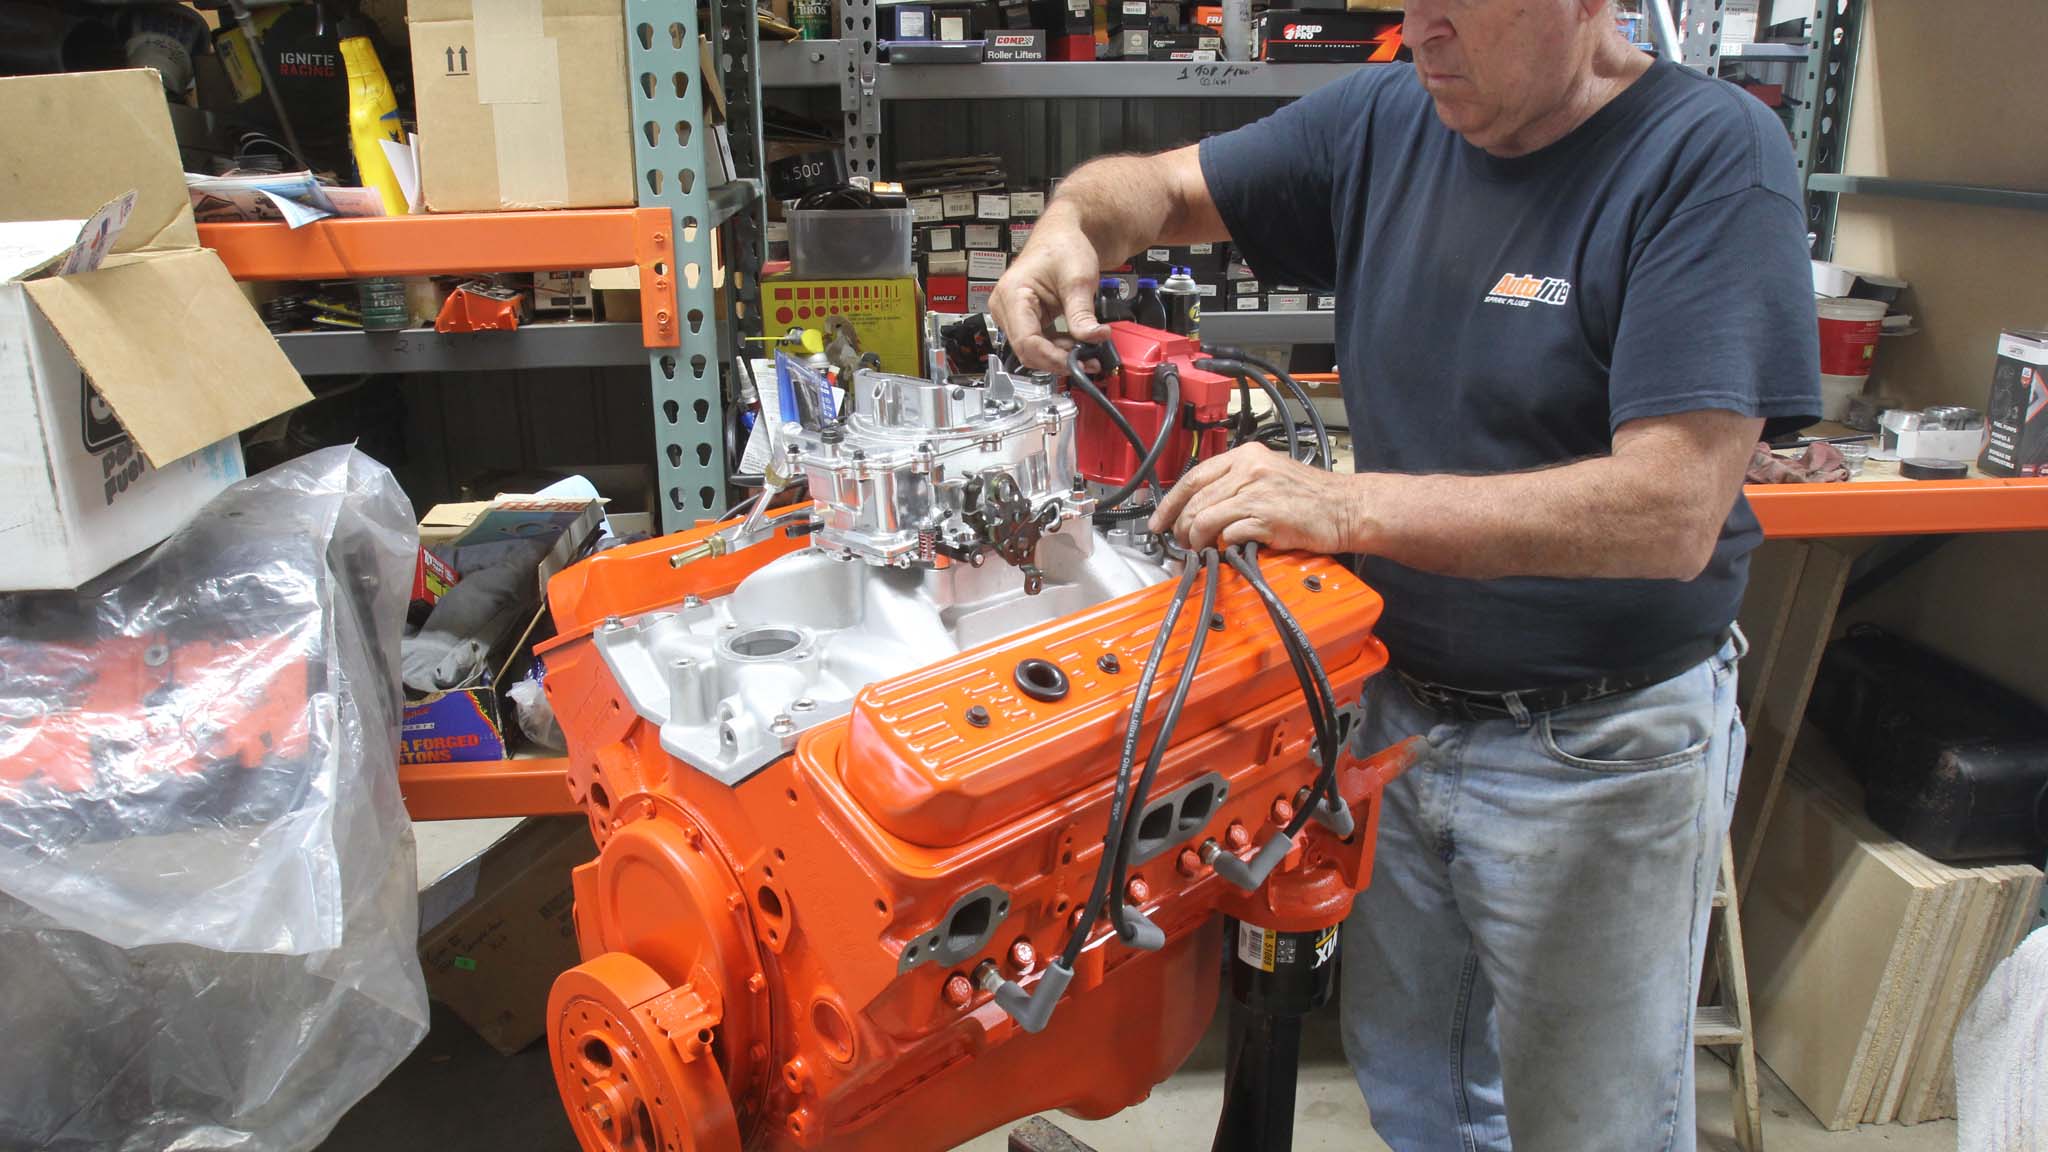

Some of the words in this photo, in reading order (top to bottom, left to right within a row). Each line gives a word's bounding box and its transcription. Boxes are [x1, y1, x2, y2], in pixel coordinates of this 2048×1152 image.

[1296, 24, 1323, 33] SPEED
[996, 35, 1025, 45] COMP
[1294, 31, 1314, 40] PRO
[280, 51, 335, 66] IGNITE
[987, 51, 1013, 59] Roller
[1015, 51, 1042, 59] Lifters
[279, 64, 336, 77] RACING
[1488, 272, 1571, 306] Autolite
[1484, 295, 1509, 305] SPARK
[1506, 298, 1531, 308] PLUGS
[413, 734, 480, 752] FORGED
